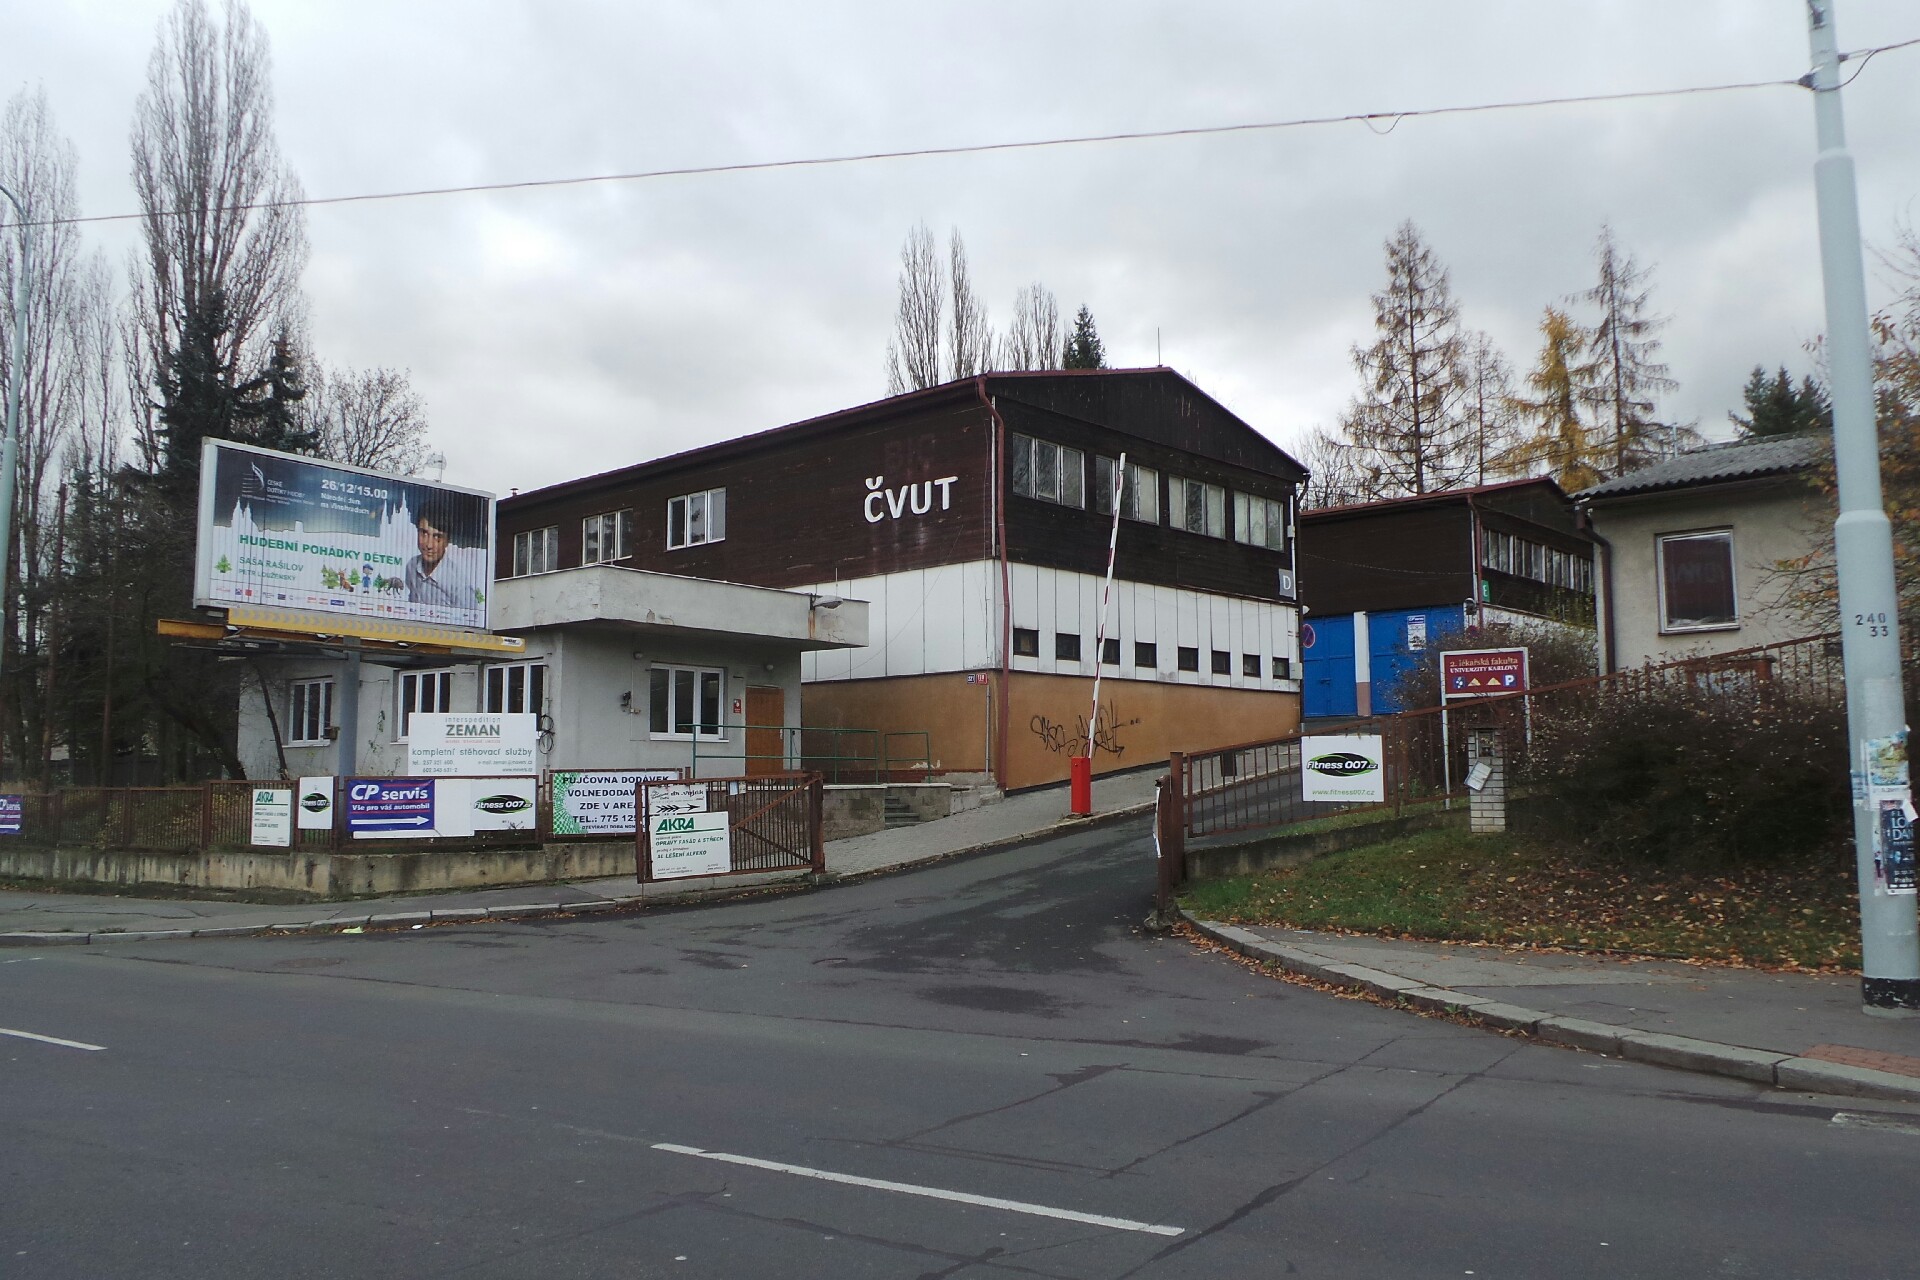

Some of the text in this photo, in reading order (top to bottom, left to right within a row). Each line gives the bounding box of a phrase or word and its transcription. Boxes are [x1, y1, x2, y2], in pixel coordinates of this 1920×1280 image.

[321, 479, 388, 499] 26/12/15.00
[864, 475, 959, 523] ČVUT
[239, 534, 299, 552] HUDEBNÍ
[302, 544, 361, 560] POHÁDKY
[239, 555, 263, 566] SAŠA
[1283, 575, 1291, 590] D
[1855, 612, 1886, 625] 240
[1870, 625, 1889, 637] 33
[1458, 657, 1490, 667] lékařská
[1491, 656, 1518, 665] fakulta
[1449, 664, 1518, 674] UNIVERZITY KARLOVY
[1504, 674, 1515, 686] P
[445, 724, 501, 736] ZEMAN
[412, 747, 533, 757] kompletní stěhovací služby
[1306, 761, 1343, 769] fitness
[351, 784, 428, 801] CP servis
[567, 789, 636, 797] VOLNEDODAV
[352, 803, 366, 811] Vše
[380, 803, 393, 811] váš
[393, 803, 430, 811] automobil
[473, 801, 504, 810] fitness
[579, 802, 600, 810] ZDE
[600, 815, 618, 823] 775
[656, 817, 695, 833] AKRA
[665, 851, 685, 859] LEŠENÍ
